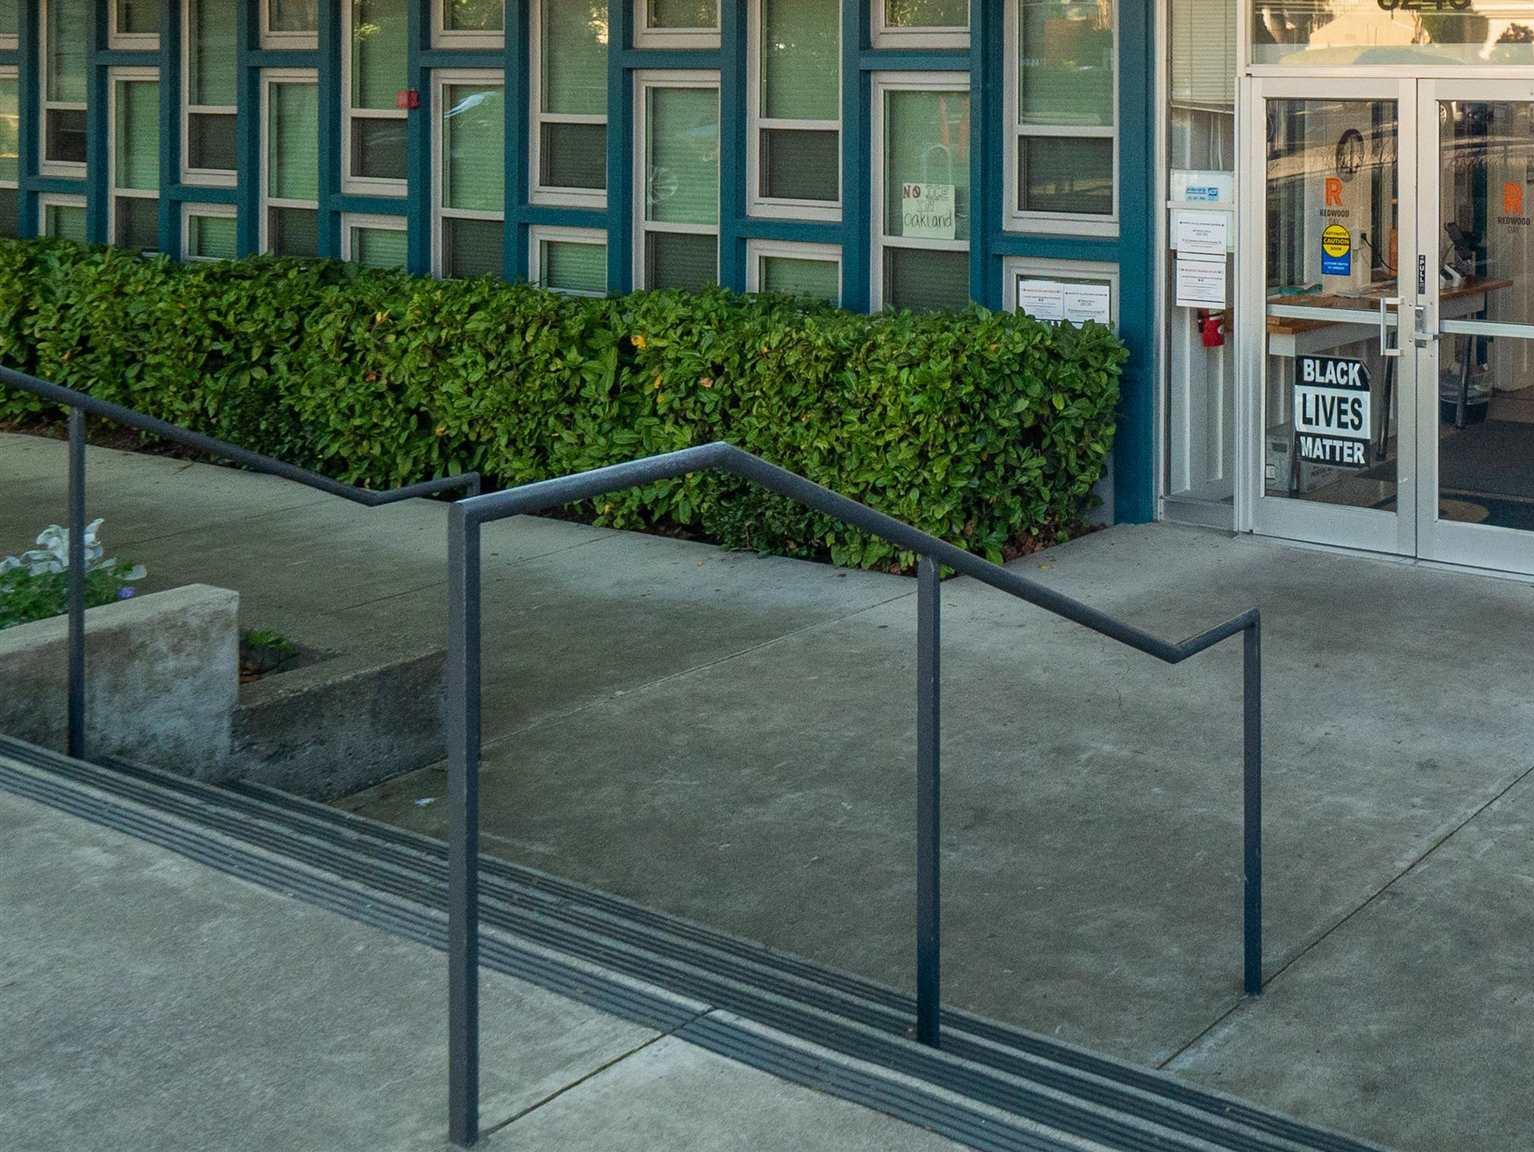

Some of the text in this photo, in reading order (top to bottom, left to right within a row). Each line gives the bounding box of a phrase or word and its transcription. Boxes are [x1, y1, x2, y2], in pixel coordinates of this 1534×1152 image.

[1303, 358, 1362, 386] BLACK
[1302, 393, 1363, 431] LIVES
[1300, 436, 1366, 464] MATTER
